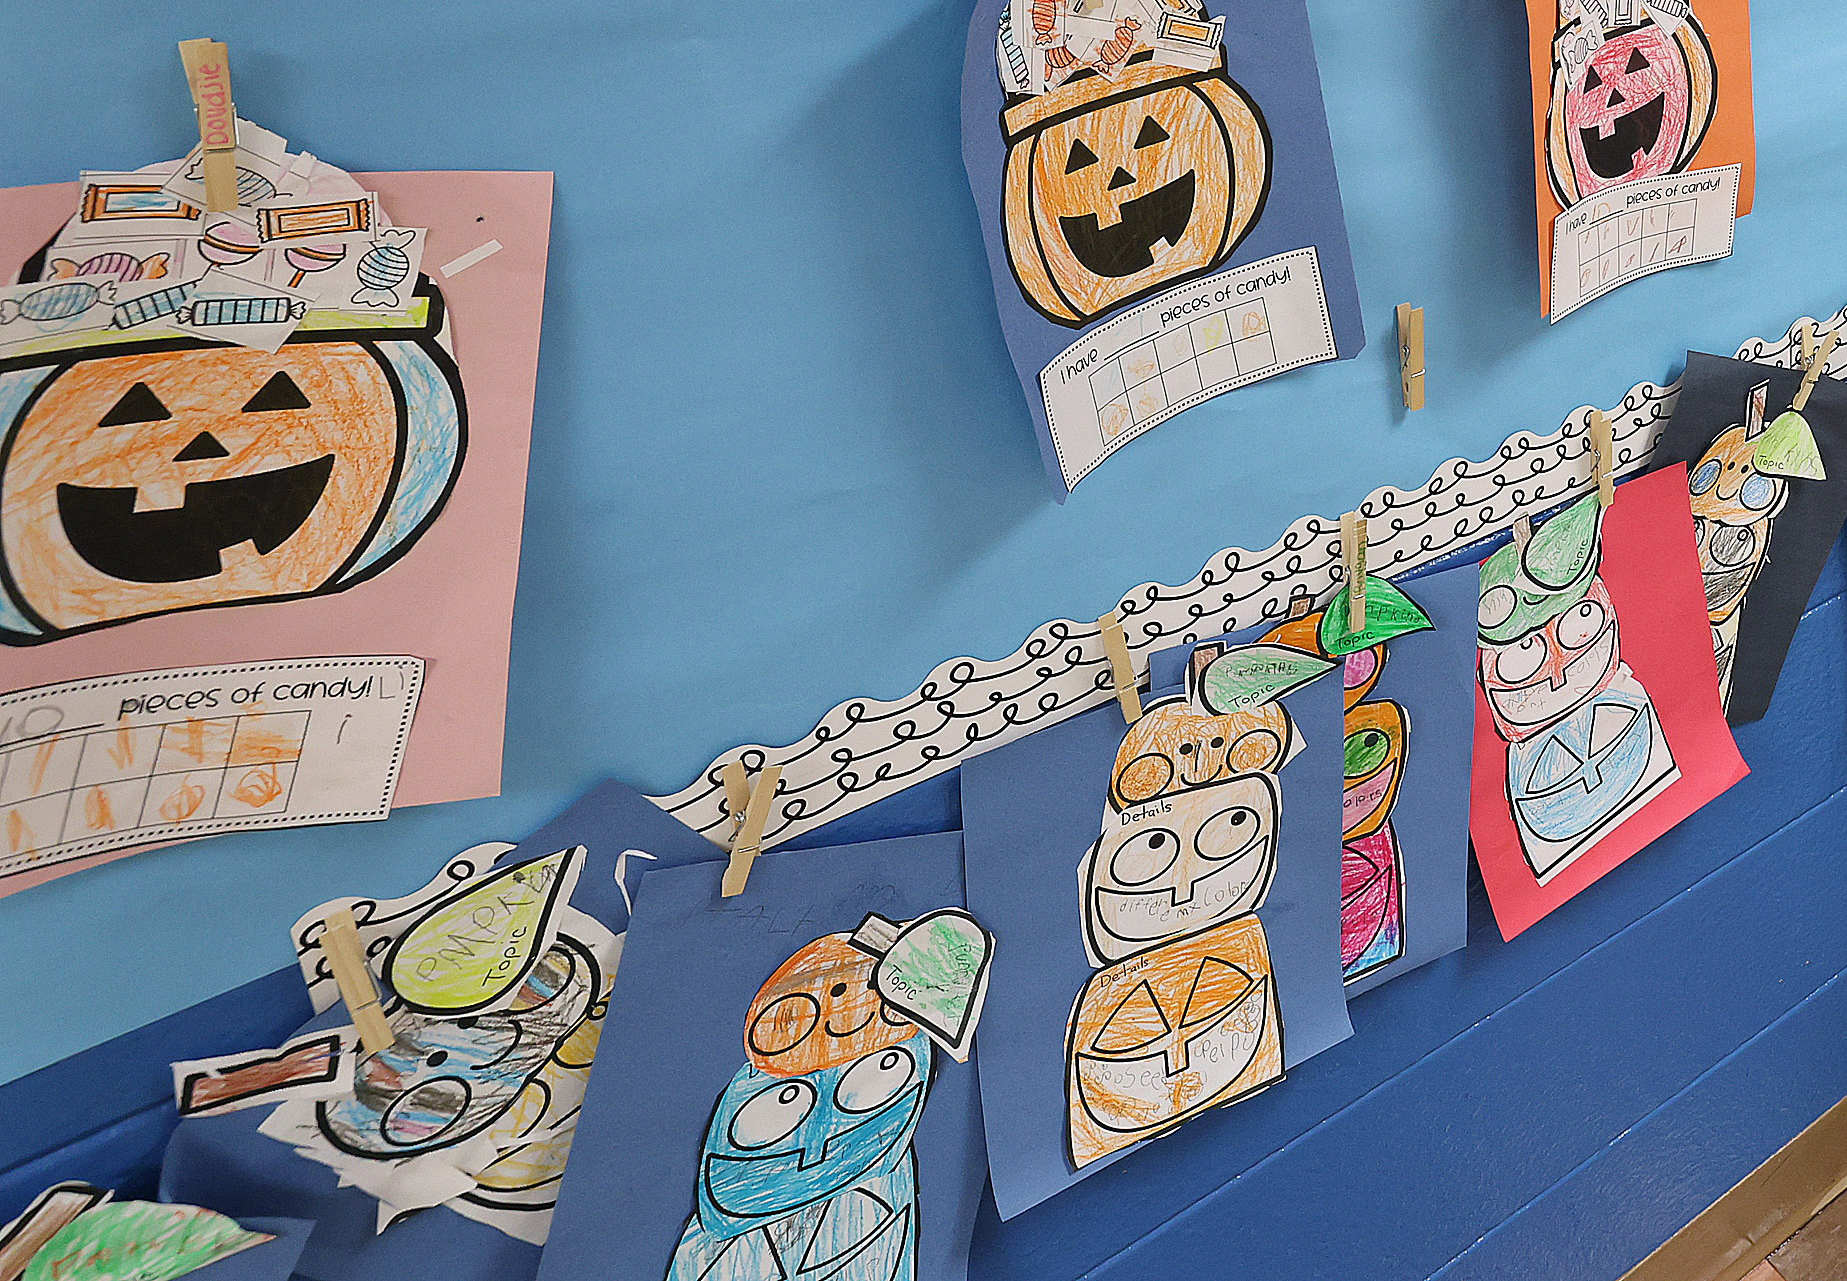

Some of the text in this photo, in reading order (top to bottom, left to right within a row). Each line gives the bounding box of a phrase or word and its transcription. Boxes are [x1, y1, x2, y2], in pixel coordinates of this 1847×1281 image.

[1568, 212, 1588, 231] have
[1626, 187, 1663, 209] pieces
[1665, 185, 1679, 199] of
[1681, 177, 1721, 195] candy!
[1067, 348, 1099, 380] have
[1159, 294, 1211, 329] pieces
[1215, 284, 1231, 303] of
[1236, 266, 1292, 296] candy!
[1759, 455, 1784, 470] Topic
[1567, 538, 1589, 575] Topic
[1334, 630, 1376, 651] Topic
[117, 686, 220, 720] pieces
[231, 681, 264, 705] of
[274, 675, 373, 705] candy!
[1228, 682, 1276, 709] Topic
[1121, 799, 1173, 826] Details
[482, 926, 527, 987] Topic
[1099, 955, 1150, 988] Details
[885, 964, 919, 1001] Topic
